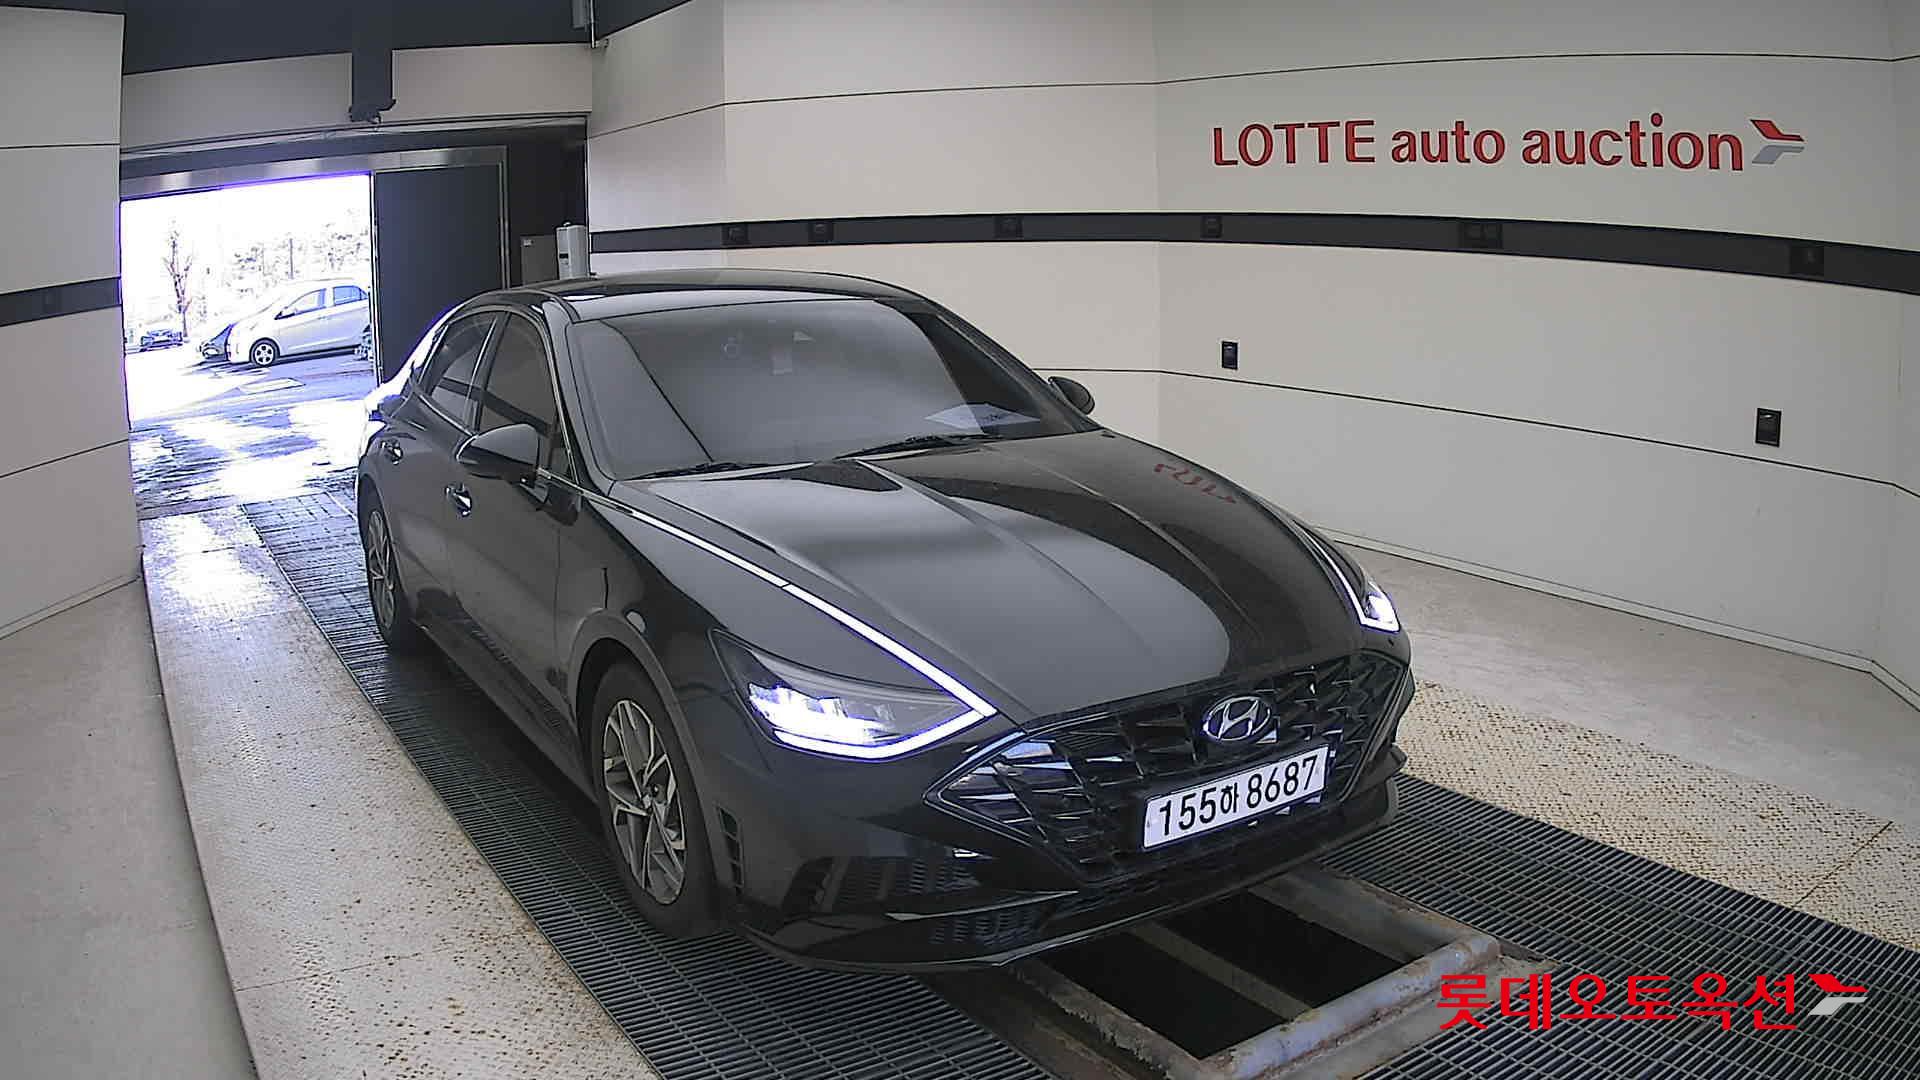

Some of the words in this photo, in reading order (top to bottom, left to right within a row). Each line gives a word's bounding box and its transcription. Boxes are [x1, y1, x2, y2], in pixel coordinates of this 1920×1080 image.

[1212, 119, 1375, 166] LOTTE
[1391, 120, 1505, 164] auto
[1521, 113, 1743, 172] auction
[1159, 782, 1239, 836] 155하
[1246, 754, 1318, 809] 8687
